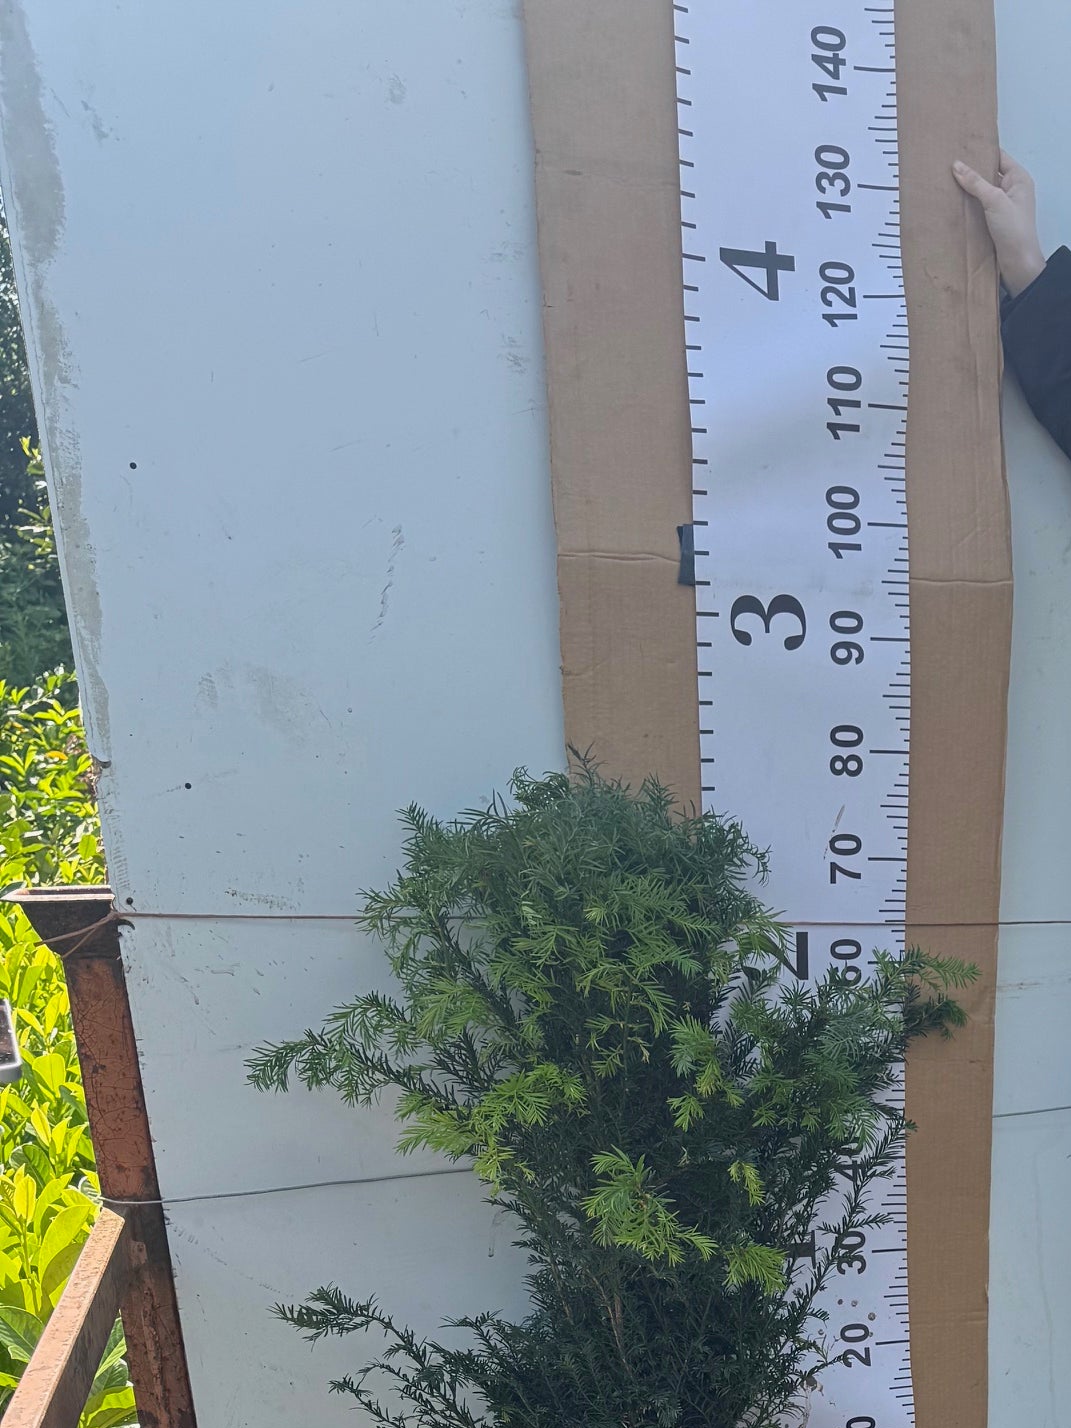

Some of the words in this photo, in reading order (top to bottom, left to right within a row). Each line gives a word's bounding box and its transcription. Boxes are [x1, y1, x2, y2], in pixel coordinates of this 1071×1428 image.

[811, 25, 847, 102] 140
[814, 144, 851, 219] 130
[719, 240, 795, 301] 4
[818, 261, 857, 327] 120
[826, 365, 862, 440] 110
[825, 485, 862, 559] 100
[730, 593, 806, 651] 3
[829, 610, 864, 666] 90
[829, 724, 863, 777] 80
[830, 833, 862, 884] 70
[836, 1230, 866, 1275] 30
[840, 1322, 872, 1368] 20
